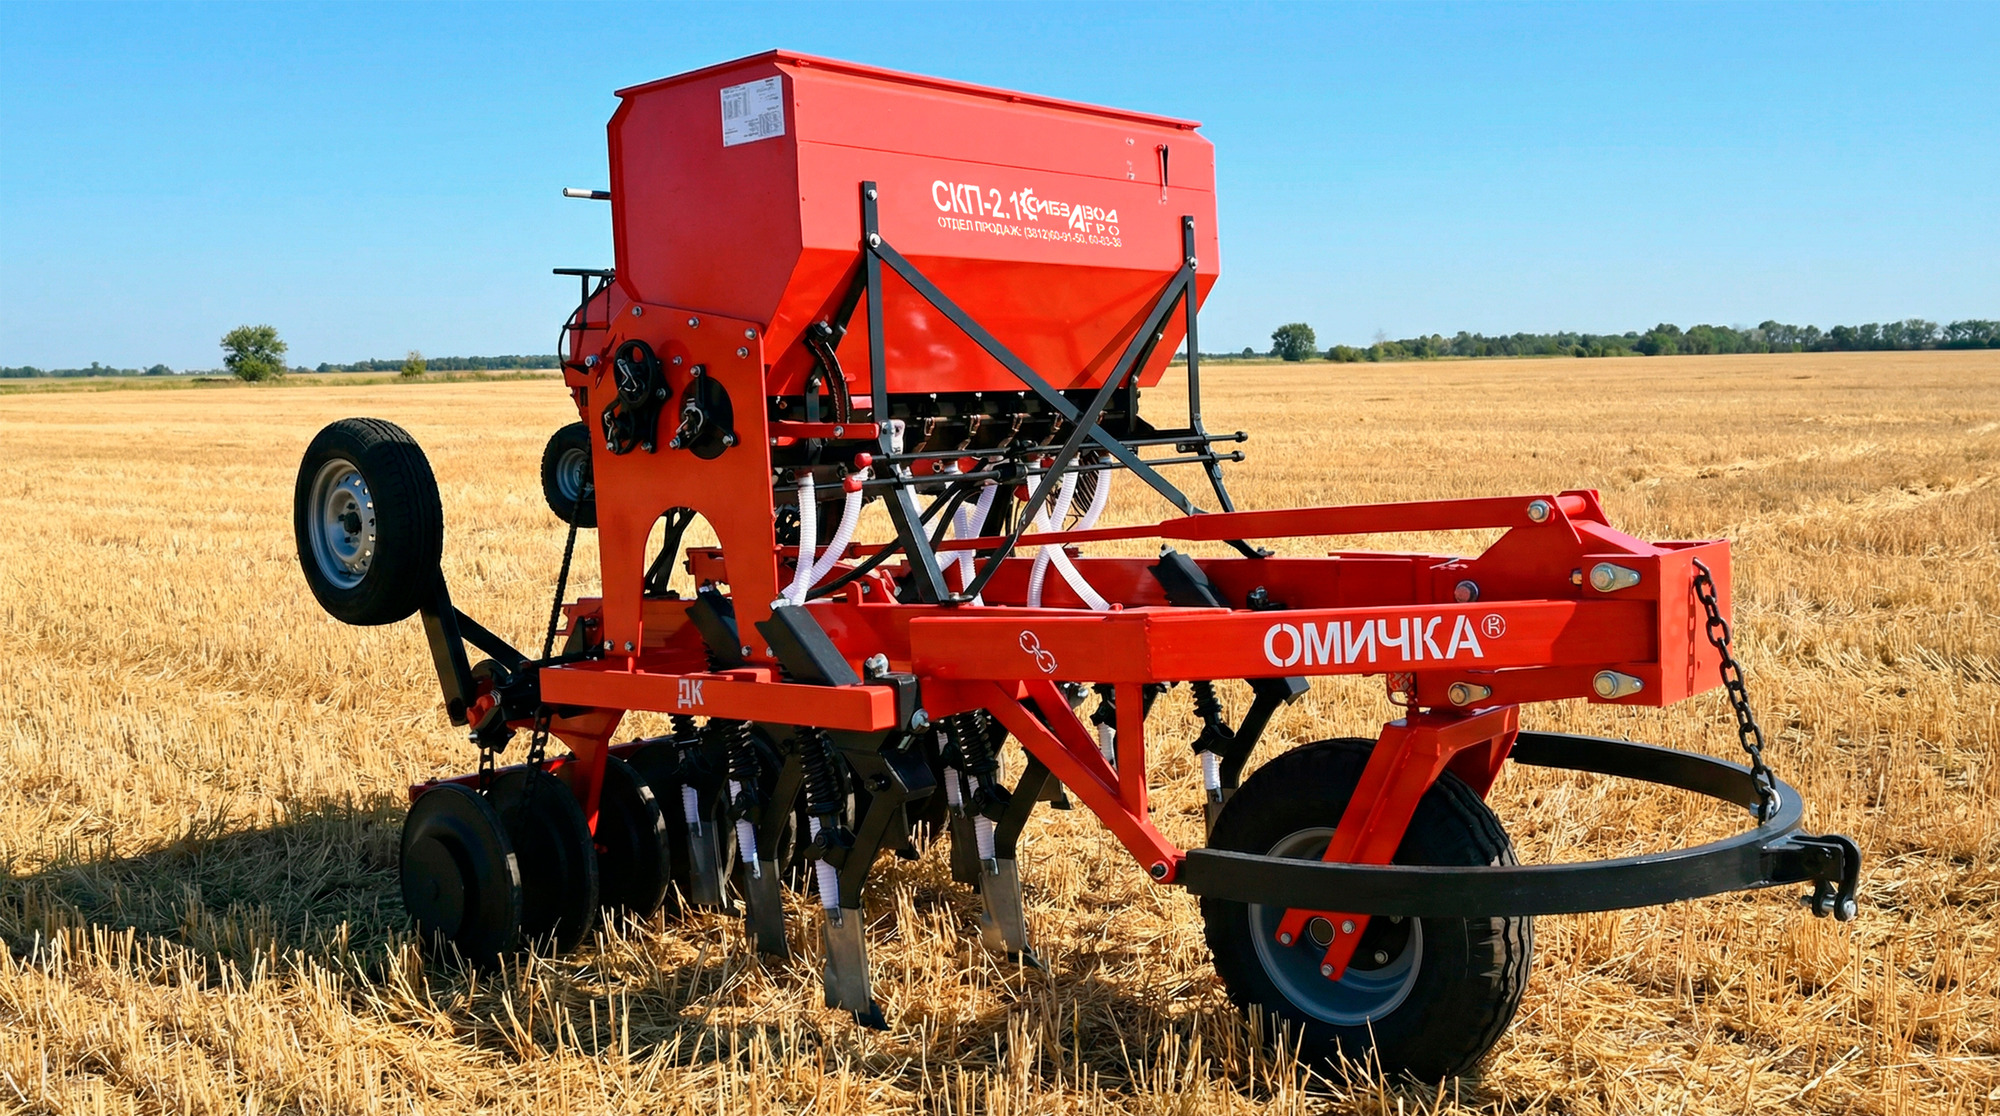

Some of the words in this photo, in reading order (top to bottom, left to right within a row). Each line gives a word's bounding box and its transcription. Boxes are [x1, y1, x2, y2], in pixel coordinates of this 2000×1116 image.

[932, 180, 1021, 220] СКП-2.1
[937, 216, 974, 231] ОТДЕЛ
[975, 220, 1022, 236] ПРОДАЖ:
[678, 679, 704, 709] ДК
